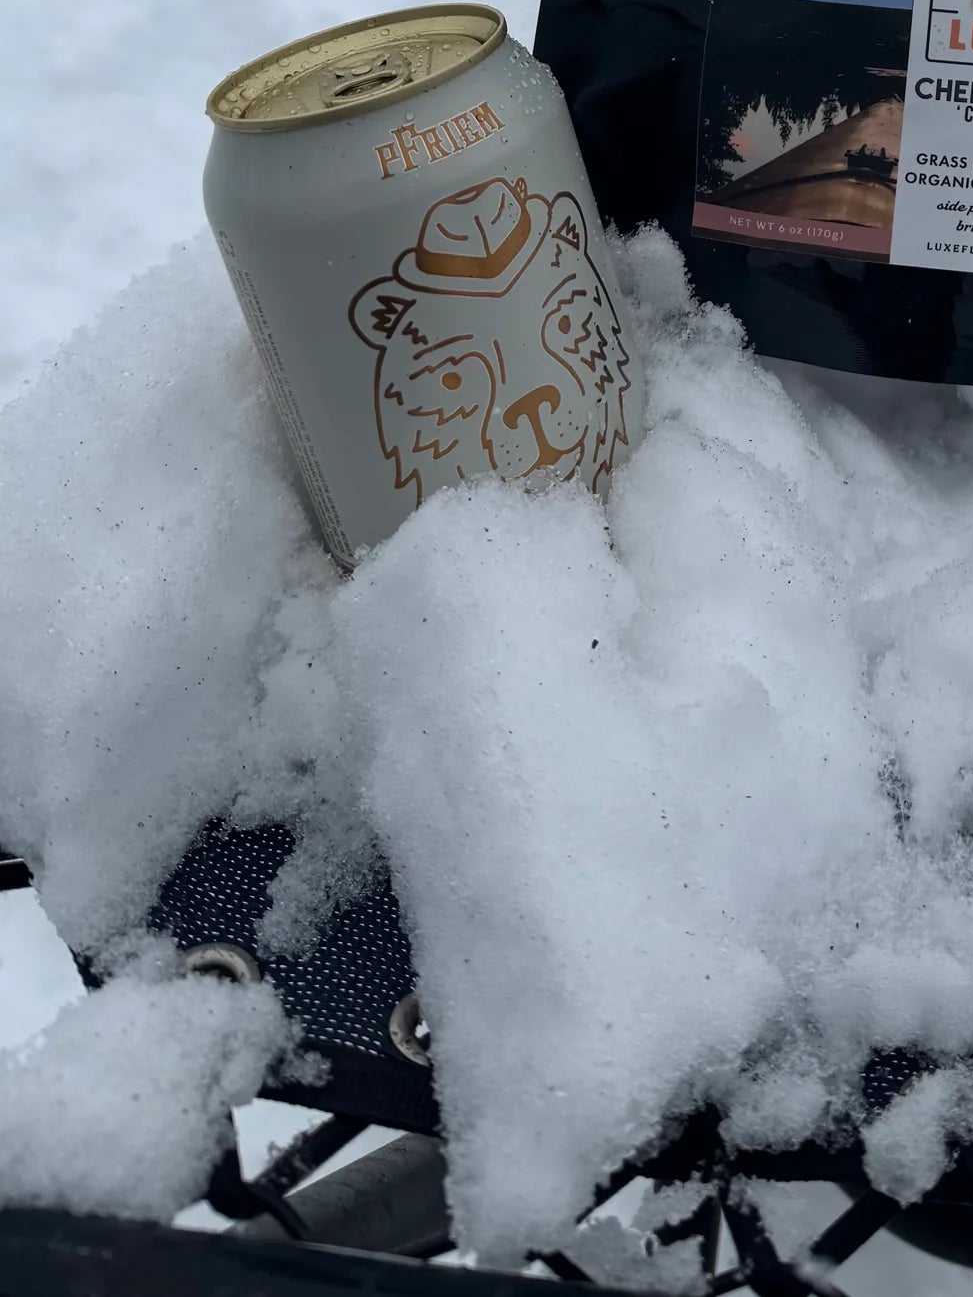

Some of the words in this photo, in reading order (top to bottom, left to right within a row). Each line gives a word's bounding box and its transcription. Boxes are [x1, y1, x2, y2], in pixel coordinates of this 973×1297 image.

[916, 153, 968, 169] GRASS
[936, 200, 967, 213] side
[729, 215, 752, 228] NET
[756, 220, 775, 231] WT
[778, 224, 786, 233] 6
[789, 227, 803, 235] oz
[807, 227, 844, 242] (170g)
